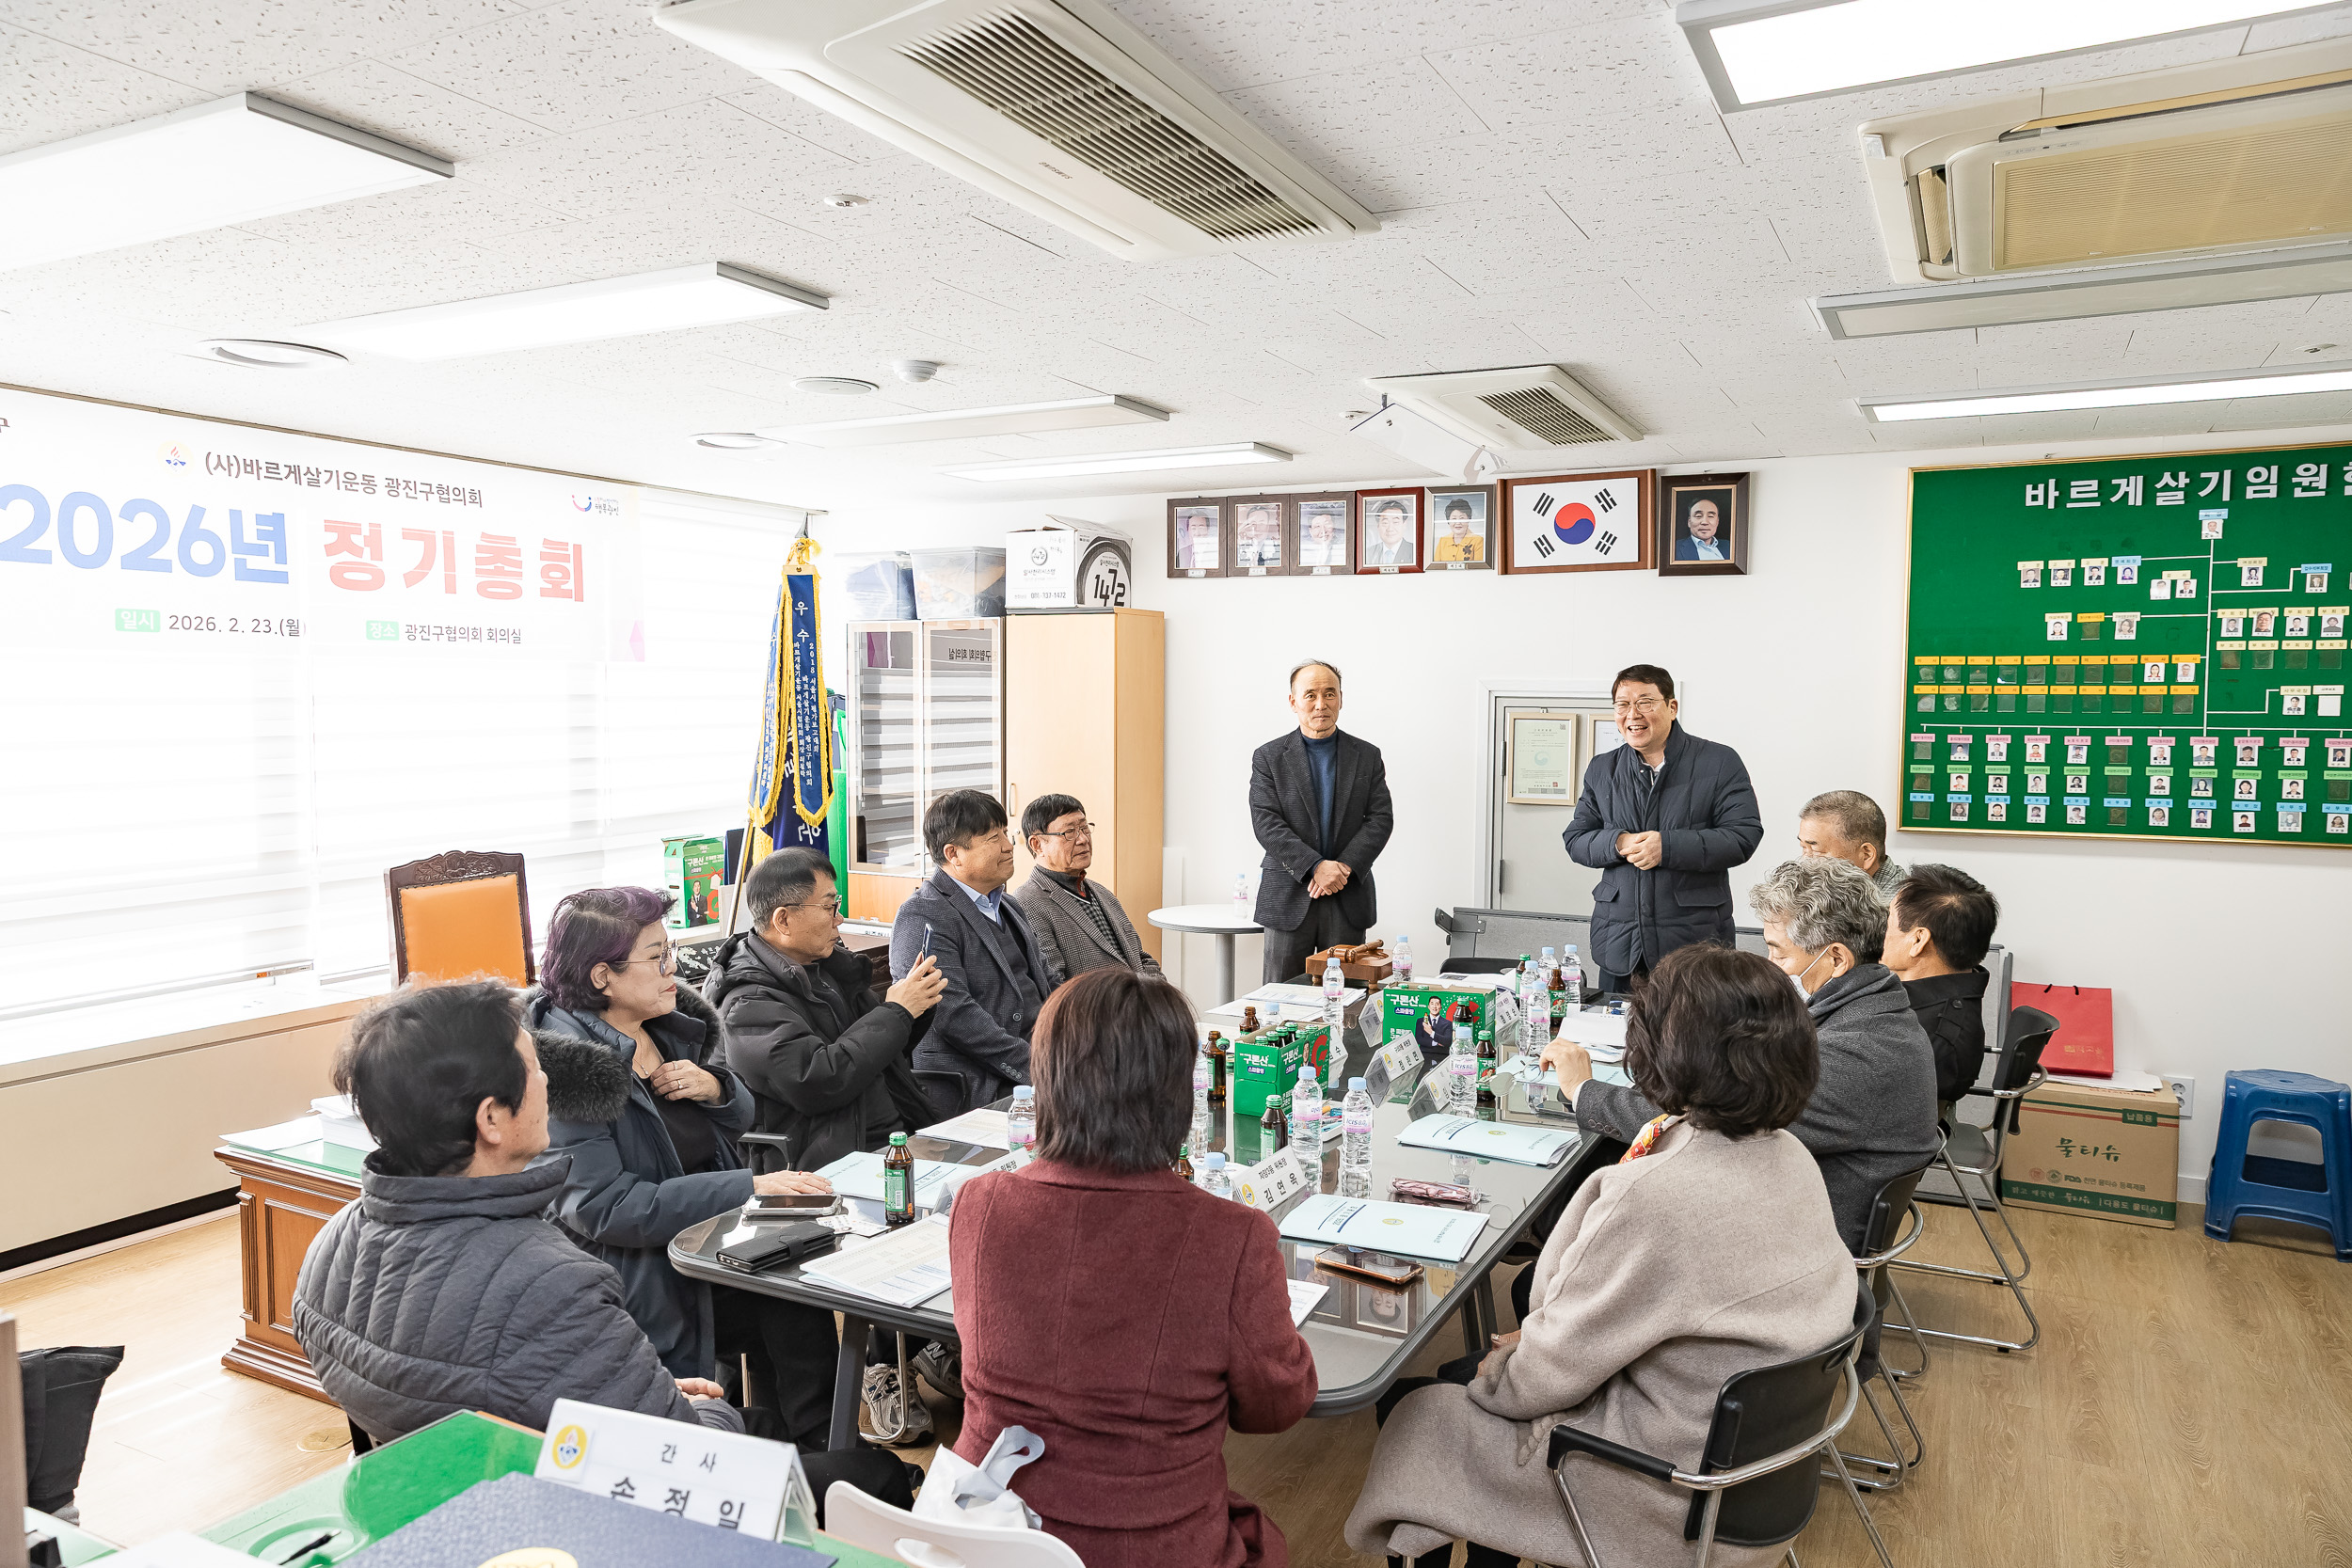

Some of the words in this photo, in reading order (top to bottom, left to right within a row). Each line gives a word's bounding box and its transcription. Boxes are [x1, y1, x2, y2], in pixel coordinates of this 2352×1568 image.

[204, 451, 378, 497] (사)바르게살기운동
[384, 475, 484, 509] 광진구협의회
[2024, 462, 2352, 510] 바르게살기임원
[0, 483, 290, 585] 2026년
[323, 519, 585, 603] 정기총회
[1094, 568, 1126, 608] 1472
[168, 614, 223, 634] 2026.
[229, 617, 246, 634] 2.
[405, 625, 484, 643] 광진구협의회
[485, 626, 522, 644] 회의실
[1390, 994, 1420, 1007] 구론산
[1243, 1053, 1269, 1067] 구론산
[2055, 1137, 2122, 1163] 물티슈
